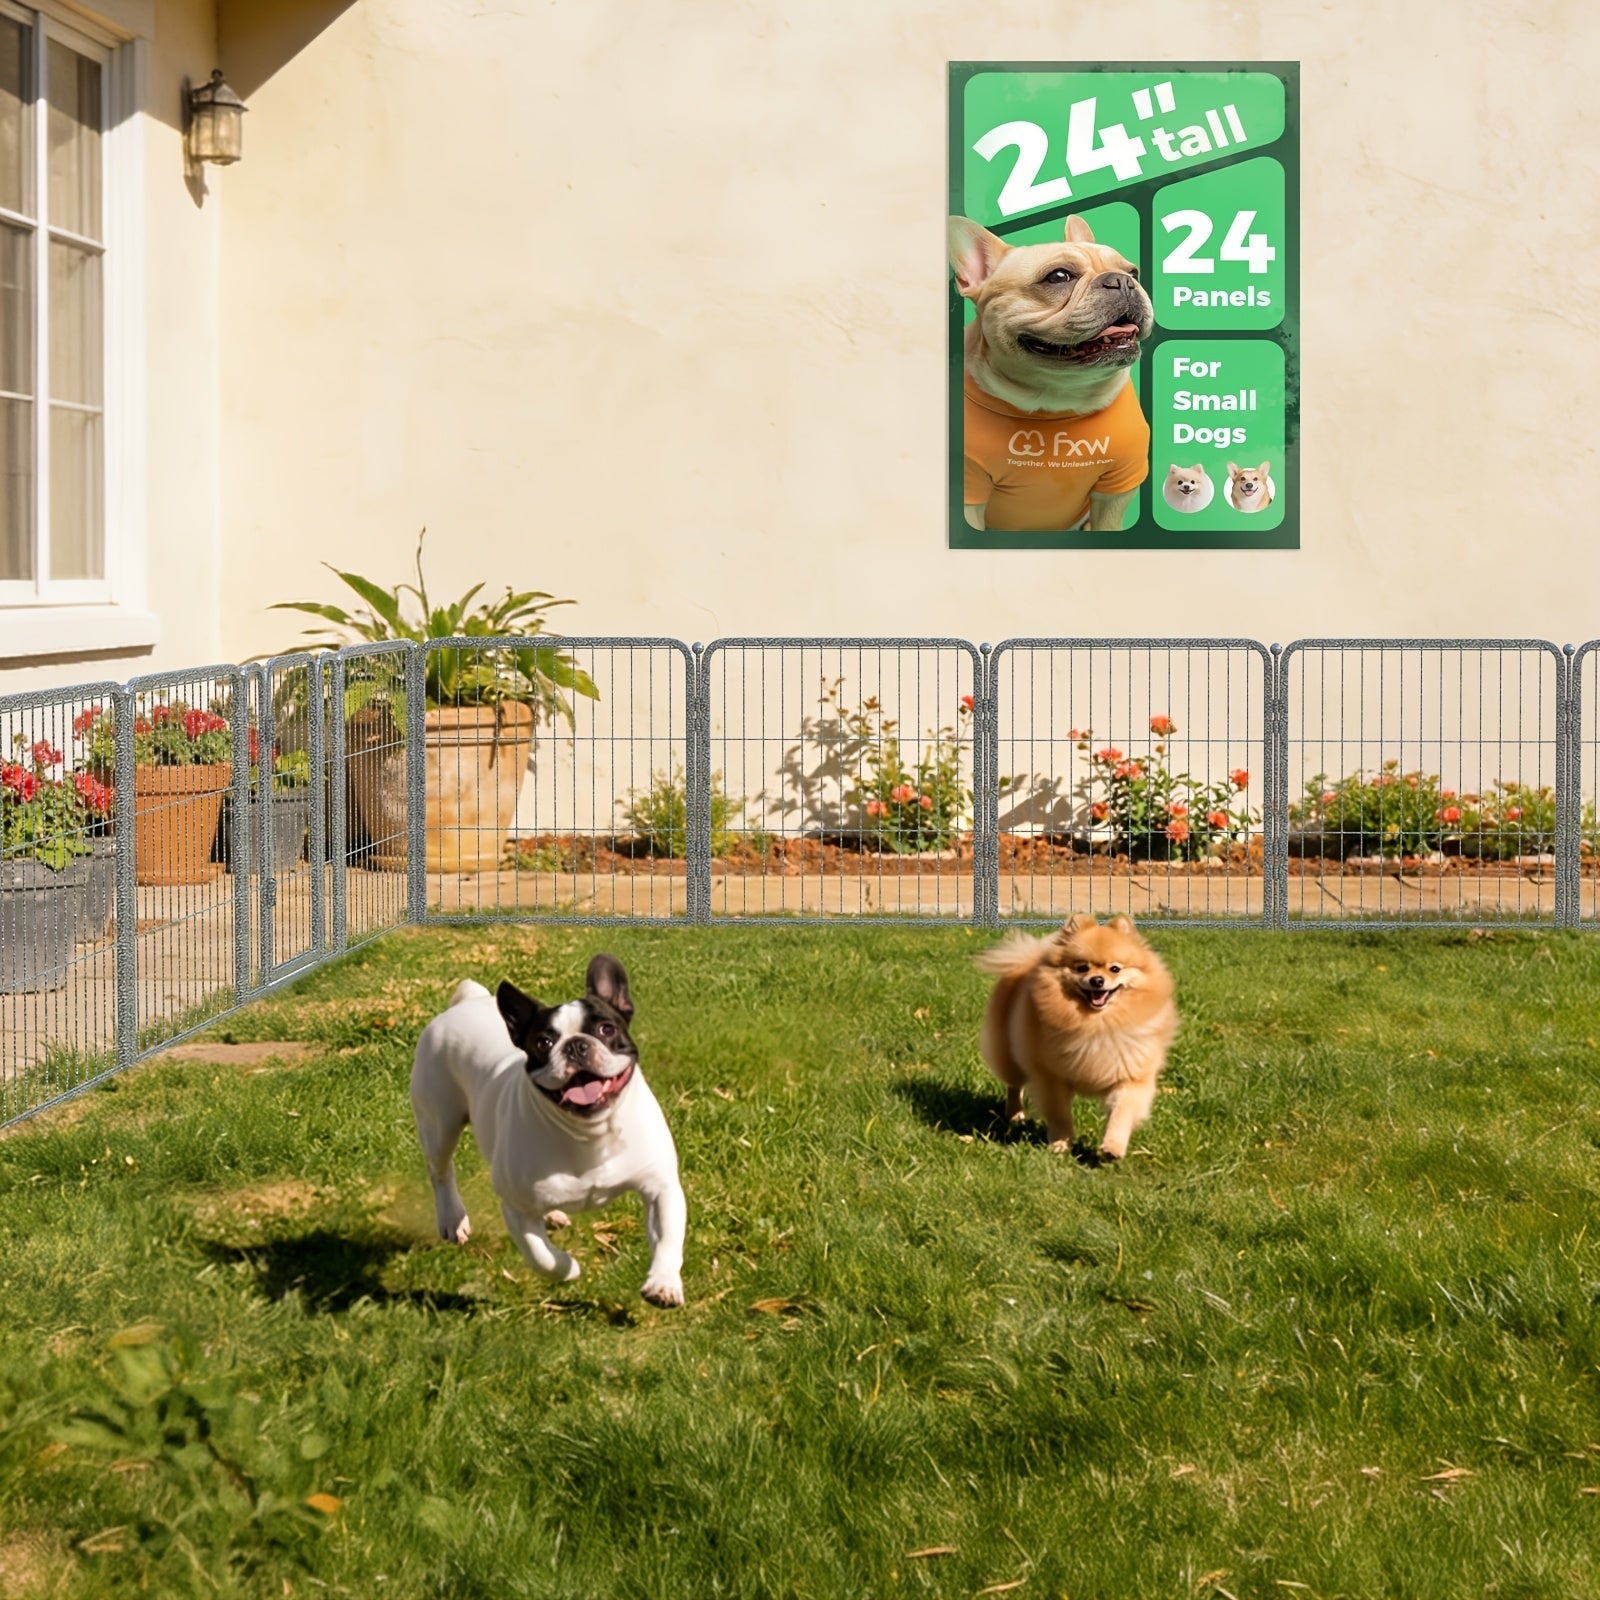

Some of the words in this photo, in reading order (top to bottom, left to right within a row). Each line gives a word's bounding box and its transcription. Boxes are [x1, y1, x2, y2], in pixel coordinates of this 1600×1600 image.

[972, 81, 1177, 217] 24"
[1151, 104, 1248, 163] tall
[1161, 209, 1276, 274] 24
[1172, 285, 1272, 307] Panels
[1172, 357, 1222, 378] For
[1172, 389, 1257, 411] Small
[1172, 423, 1247, 448] Dogs
[1061, 460, 1095, 468] Unleash
